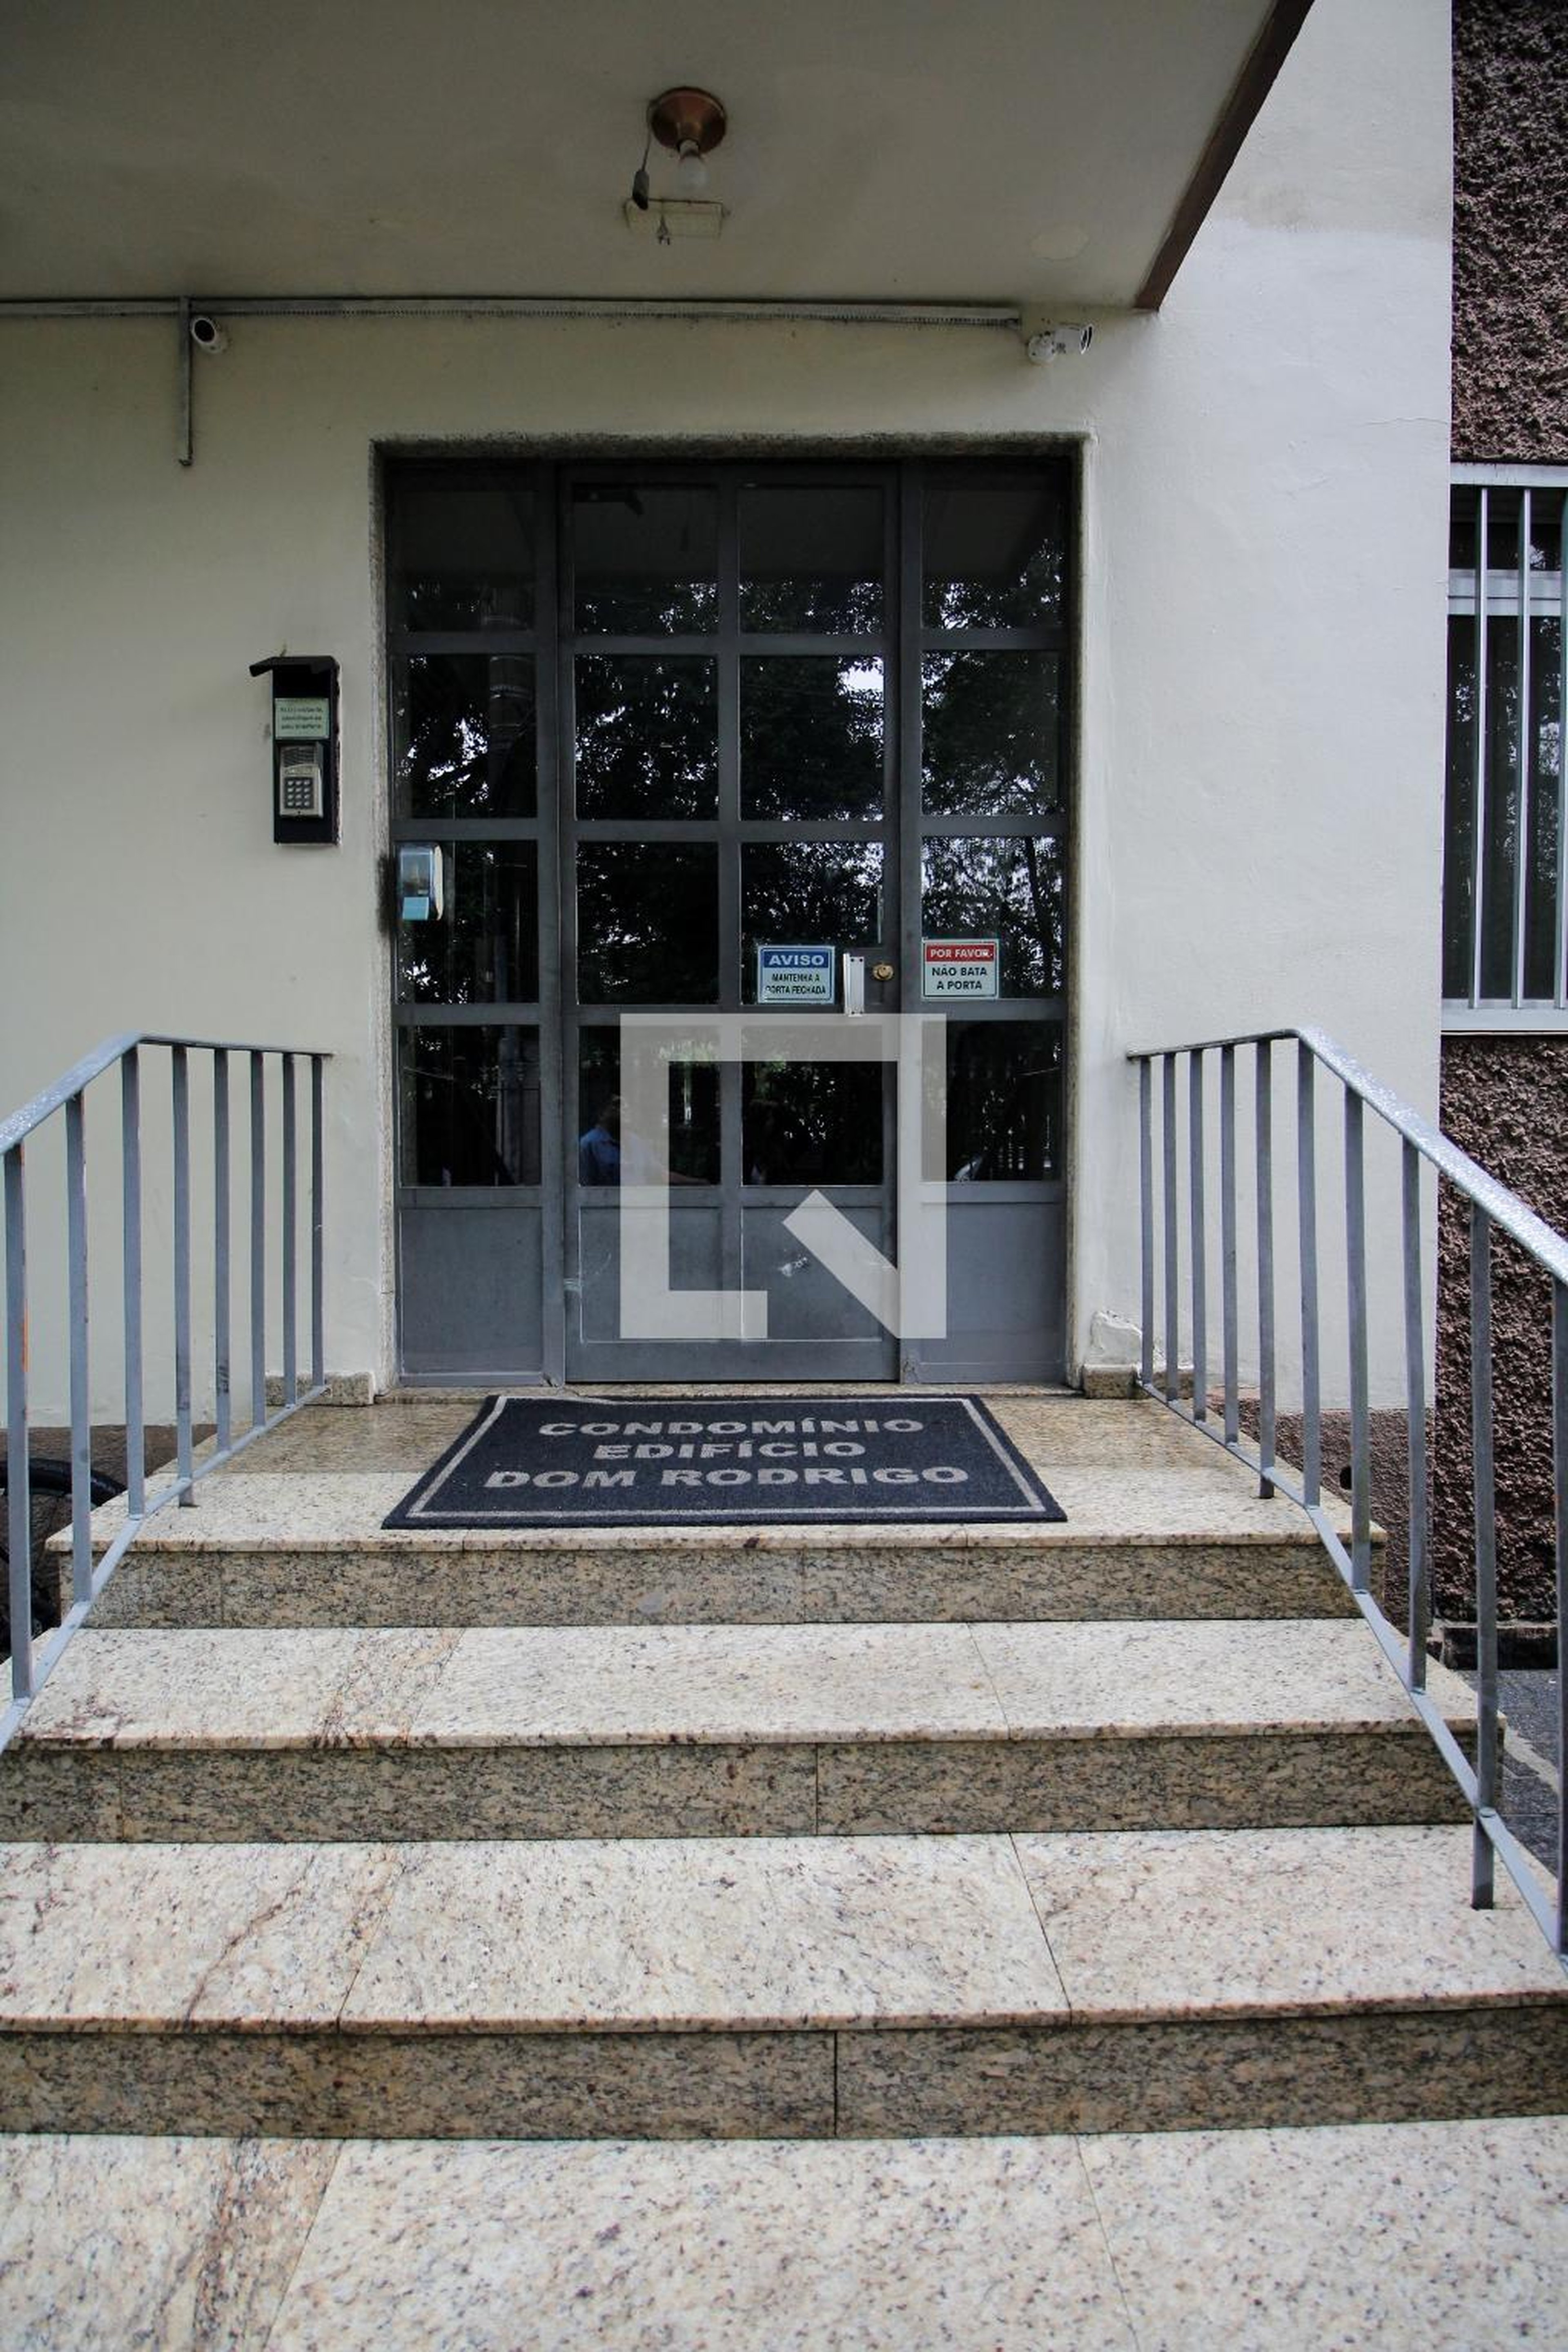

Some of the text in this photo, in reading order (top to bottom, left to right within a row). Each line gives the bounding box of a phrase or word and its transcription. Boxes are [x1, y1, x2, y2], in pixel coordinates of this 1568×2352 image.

[931, 949, 951, 958] POR
[768, 955, 824, 965] AVISO
[932, 964, 987, 976] NÃO BATA
[771, 973, 820, 982] MANTENHA A
[791, 985, 826, 994] FECHADA
[937, 981, 982, 990] A PORTA
[538, 1417, 924, 1436] CONDOMÍNIO
[592, 1440, 866, 1460] EDIFÍCIO
[483, 1466, 969, 1488] DOM RODRIGO
